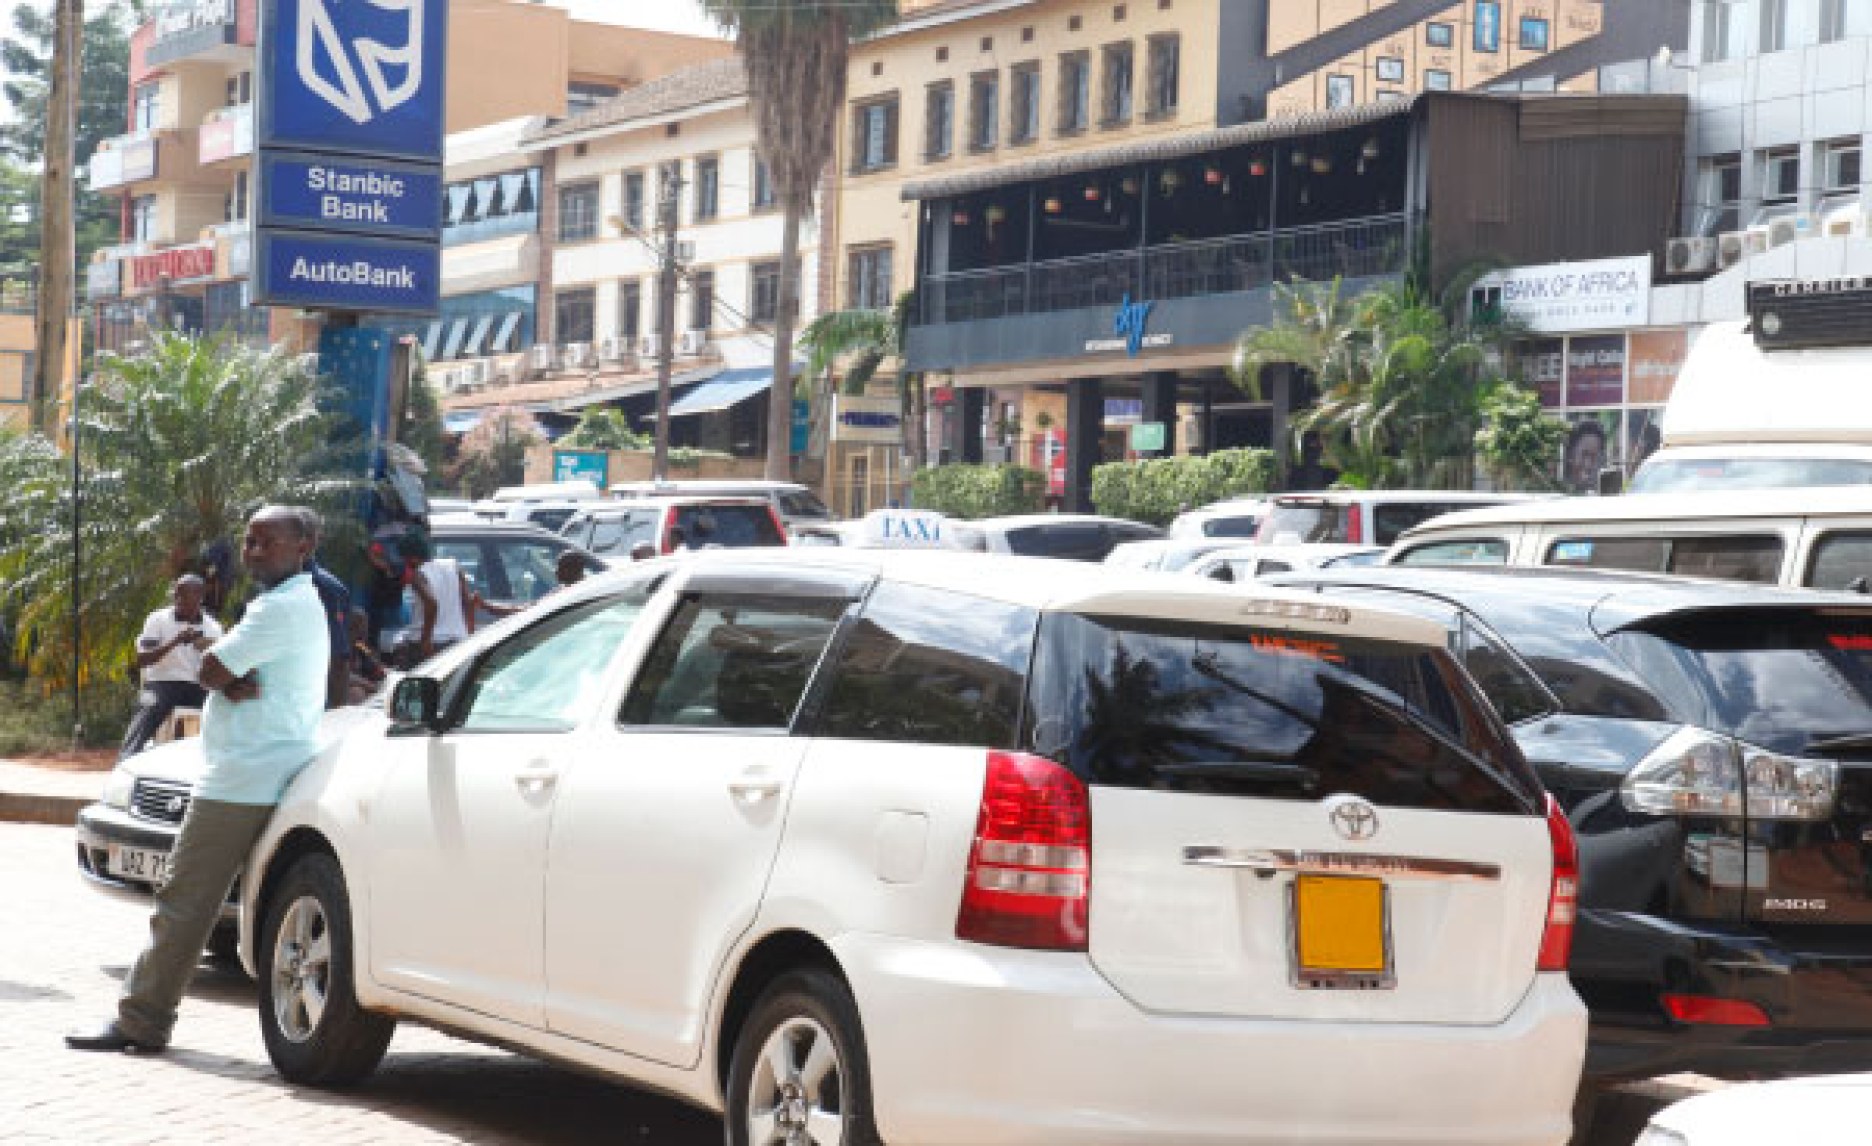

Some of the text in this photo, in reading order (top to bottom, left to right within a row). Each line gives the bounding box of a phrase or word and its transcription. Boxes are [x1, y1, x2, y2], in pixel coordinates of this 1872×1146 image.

[308, 166, 404, 198] Stanbic
[321, 194, 388, 222] Bank
[290, 257, 416, 288] AutoBank
[1504, 270, 1639, 300] BANK OF AFRICA
